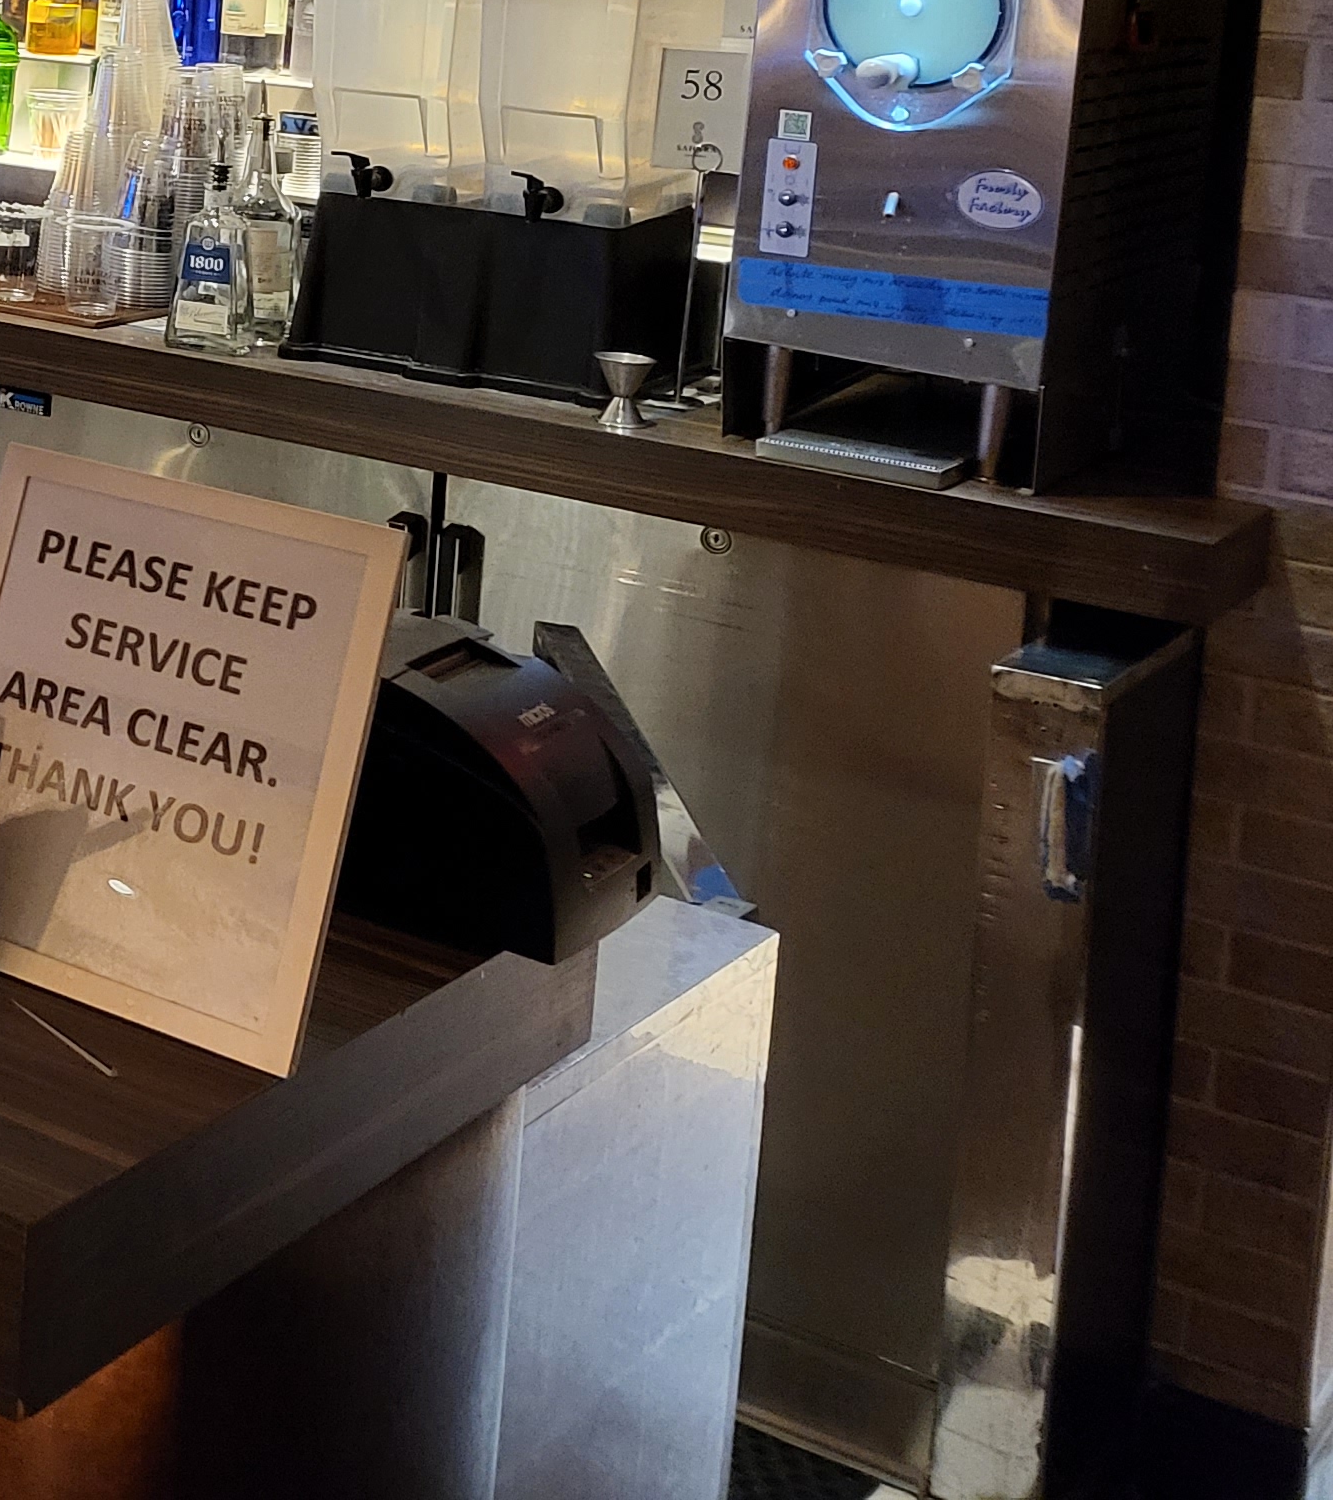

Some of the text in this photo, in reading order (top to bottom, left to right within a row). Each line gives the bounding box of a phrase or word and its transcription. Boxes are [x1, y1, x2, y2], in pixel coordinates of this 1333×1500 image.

[680, 69, 723, 102] 58
[189, 254, 224, 272] 1800
[36, 528, 318, 631] PLEASE KEEP
[64, 611, 249, 696] SERVICE
[126, 707, 279, 788] CLEAR.
[146, 789, 266, 865] YOU!
